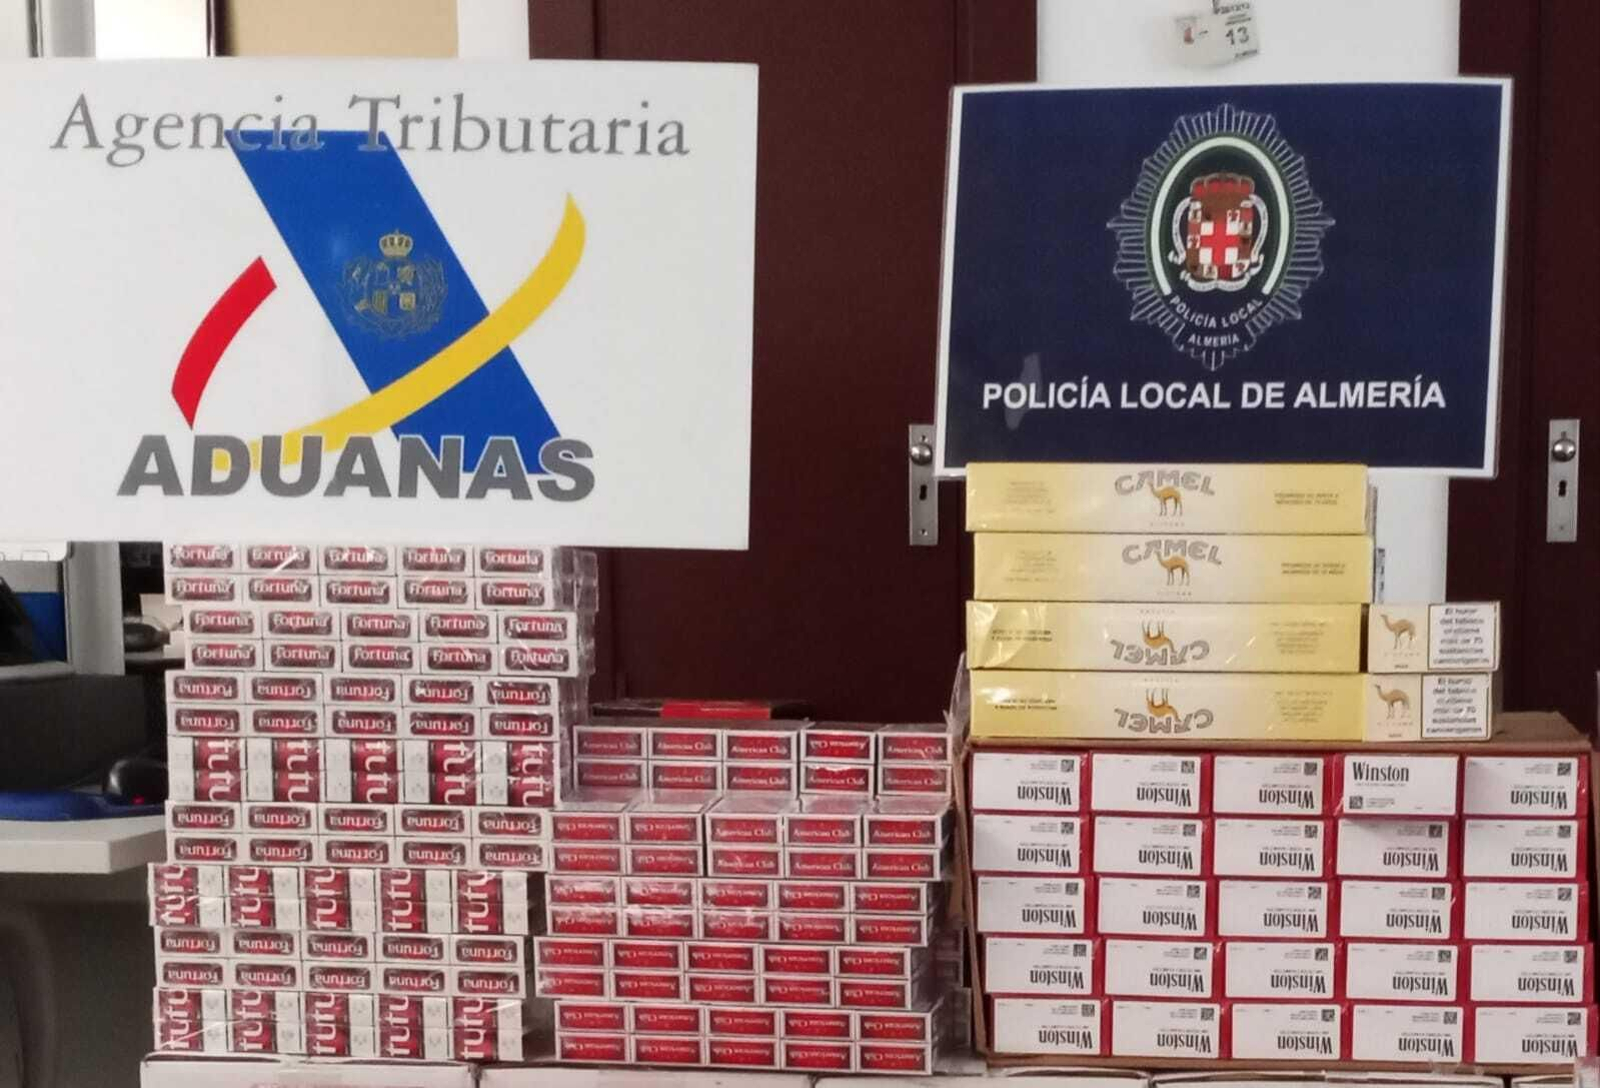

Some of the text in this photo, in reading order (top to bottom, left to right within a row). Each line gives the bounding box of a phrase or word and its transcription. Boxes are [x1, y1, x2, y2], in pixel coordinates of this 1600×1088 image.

[50, 93, 691, 168] Agencia Tributaria
[1221, 299, 1263, 328] LOCAL
[982, 374, 1447, 410] POLICÍA LOCAL DE ALMERÍA
[117, 434, 595, 502] ADUANAS
[1115, 470, 1215, 496] CAMEL
[1122, 539, 1222, 565] CAMEL
[177, 581, 230, 595] Fortuna
[253, 583, 307, 595] Fortuna
[331, 584, 385, 598] Fortuna
[409, 584, 463, 598] Fortuna
[486, 586, 540, 599] Fortuna
[195, 613, 249, 627] Fortuna
[274, 615, 328, 629] Fortuna
[352, 616, 406, 631] Fortuna
[430, 618, 486, 631] Fortuna
[509, 620, 563, 634] Fortuna
[197, 647, 251, 660] Fortuna
[276, 649, 330, 662] Fortuna
[354, 649, 409, 662] Fortuna
[433, 650, 486, 664] Fortuna
[511, 651, 565, 664] Fortuna
[1110, 639, 1210, 665] CAMEL
[179, 682, 233, 696] Fortuna
[257, 684, 311, 698] Fortuna
[335, 685, 390, 699] Fortuna
[416, 686, 468, 700] Fortuna
[493, 687, 547, 701] Fortuna
[180, 716, 235, 731] Fortuna
[259, 717, 312, 731] Fortuna
[338, 718, 391, 732] Fortuna
[416, 718, 470, 733] Fortuna
[494, 719, 548, 733] Fortuna
[1114, 709, 1214, 734] CAMEL
[1352, 761, 1410, 782] Winston
[1018, 786, 1072, 806] Winston
[1136, 786, 1191, 806] Winston
[1259, 788, 1314, 809] Winston
[1510, 790, 1568, 810] Winston
[177, 813, 230, 826] Fortuna
[254, 813, 306, 827] Fortuna
[330, 816, 383, 829] Fortuna
[407, 816, 460, 830] Fortuna
[484, 818, 537, 832] Fortuna
[179, 844, 232, 858] Fortuna
[255, 846, 307, 859] Fortuna
[332, 847, 384, 862] Fortuna
[408, 849, 461, 862] Fortuna
[484, 849, 538, 864] Fortuna
[1018, 848, 1072, 868] Winston
[1138, 849, 1193, 870] Winston
[1259, 851, 1315, 872] Winston
[1383, 852, 1439, 872] Winston
[1510, 852, 1568, 872] Winston
[1022, 908, 1076, 928] Winston
[1142, 910, 1197, 931] Winston
[1263, 912, 1319, 932] Winston
[1386, 914, 1442, 933] Winston
[1511, 915, 1569, 934] Winston
[165, 937, 216, 952] Fortuna
[238, 937, 290, 953] Fortuna
[312, 941, 364, 955] Fortuna
[387, 942, 439, 958] Fortuna
[461, 946, 512, 960] Fortuna
[167, 967, 218, 982] Fortuna
[241, 970, 292, 984] Fortuna
[314, 973, 366, 987] Fortuna
[388, 975, 440, 989] Fortuna
[1030, 970, 1084, 989] Winston
[1150, 972, 1204, 992] Winston
[463, 978, 514, 993] Fortuna
[1271, 974, 1326, 994] Winston
[1392, 976, 1448, 996] Winston
[1518, 977, 1574, 996] Winston
[1039, 1030, 1092, 1049] Winston
[1157, 1033, 1211, 1052] Winston
[1277, 1035, 1333, 1054] Winston
[1398, 1037, 1454, 1057] Winston
[1522, 1038, 1578, 1058] Winston
